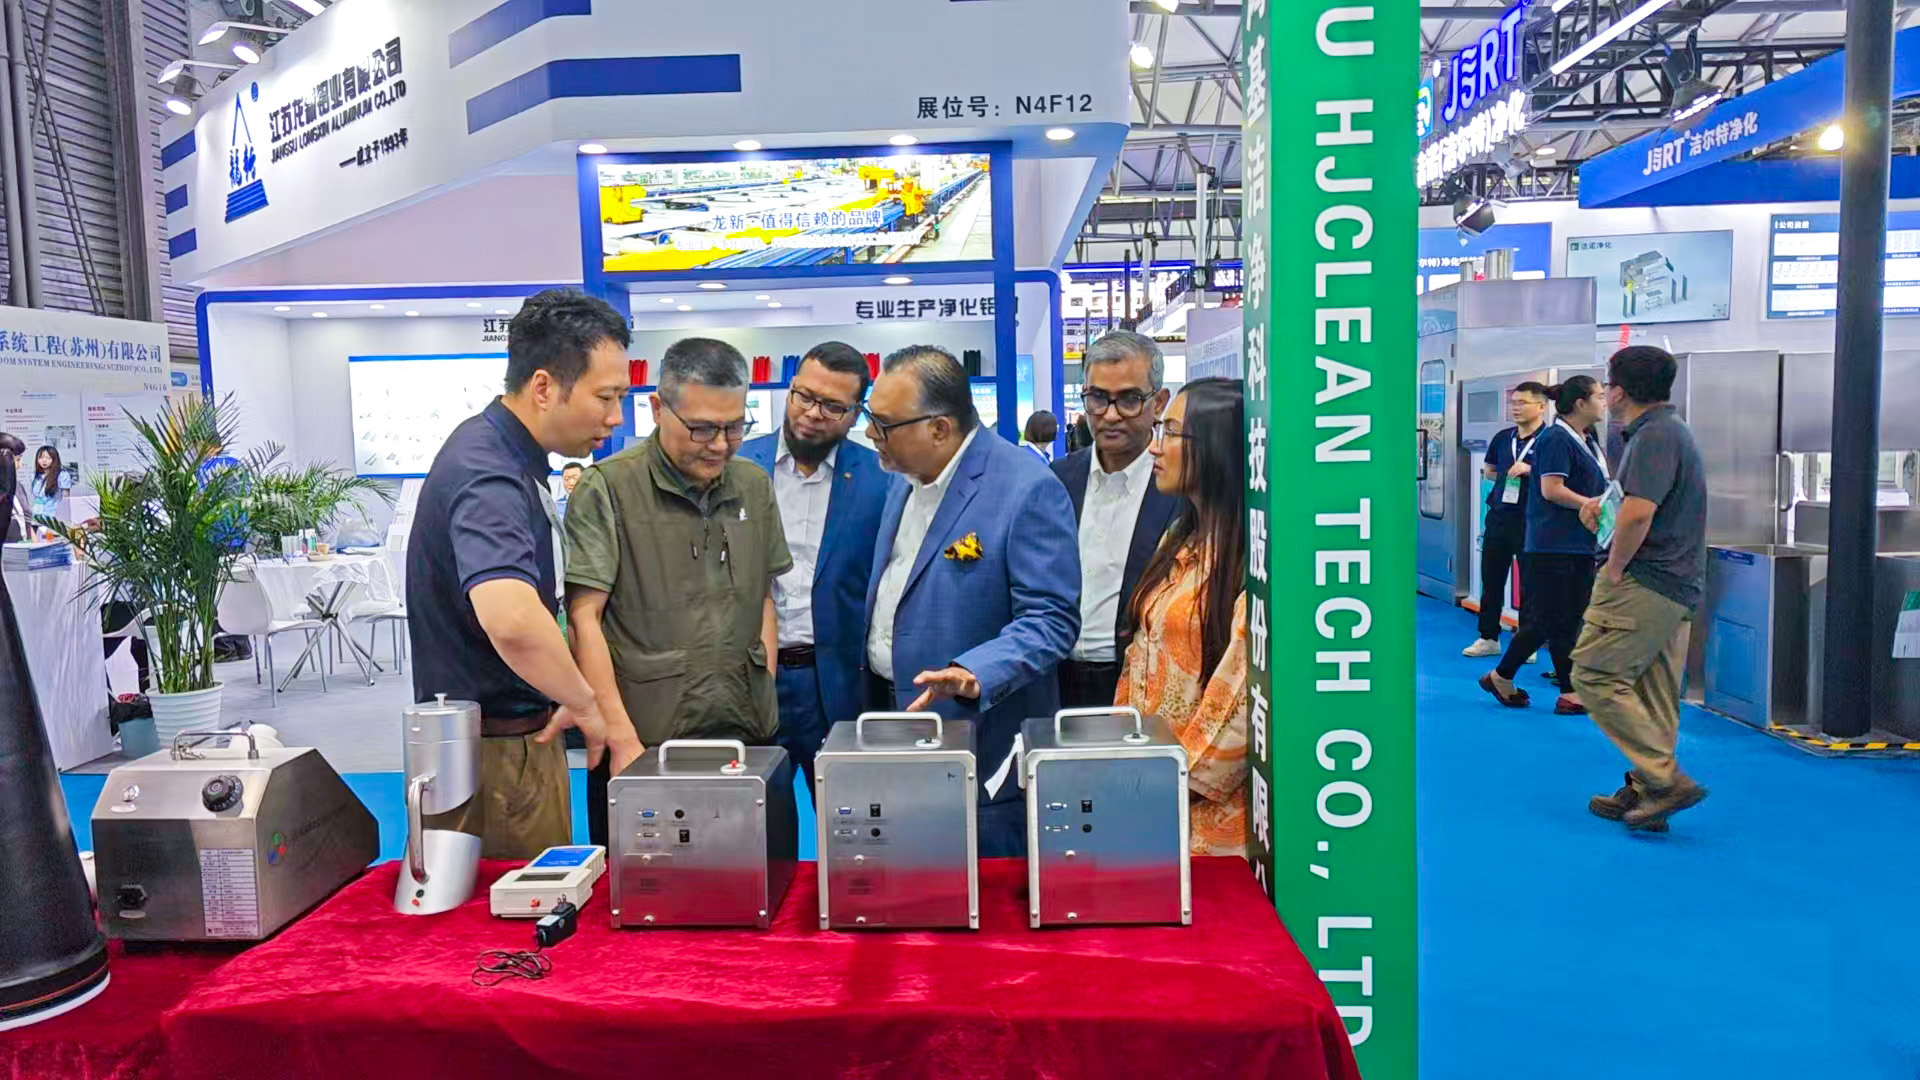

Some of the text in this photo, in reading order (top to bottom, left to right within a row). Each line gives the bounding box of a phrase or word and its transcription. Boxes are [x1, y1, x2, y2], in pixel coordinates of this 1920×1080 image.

[1016, 94, 1093, 115] N4F12
[1689, 111, 1759, 156] 洁尔特净化
[1315, 99, 1374, 463] HJCLEAN
[856, 296, 1018, 318] 专业生产净化铝
[0, 331, 162, 363] 系统工程(苏州)有限公司
[18, 357, 50, 368] SYSTEM
[1246, 0, 1269, 895] 基洁净科技股份有限
[1314, 498, 1372, 692] TECH
[1310, 728, 1372, 879] CO.,
